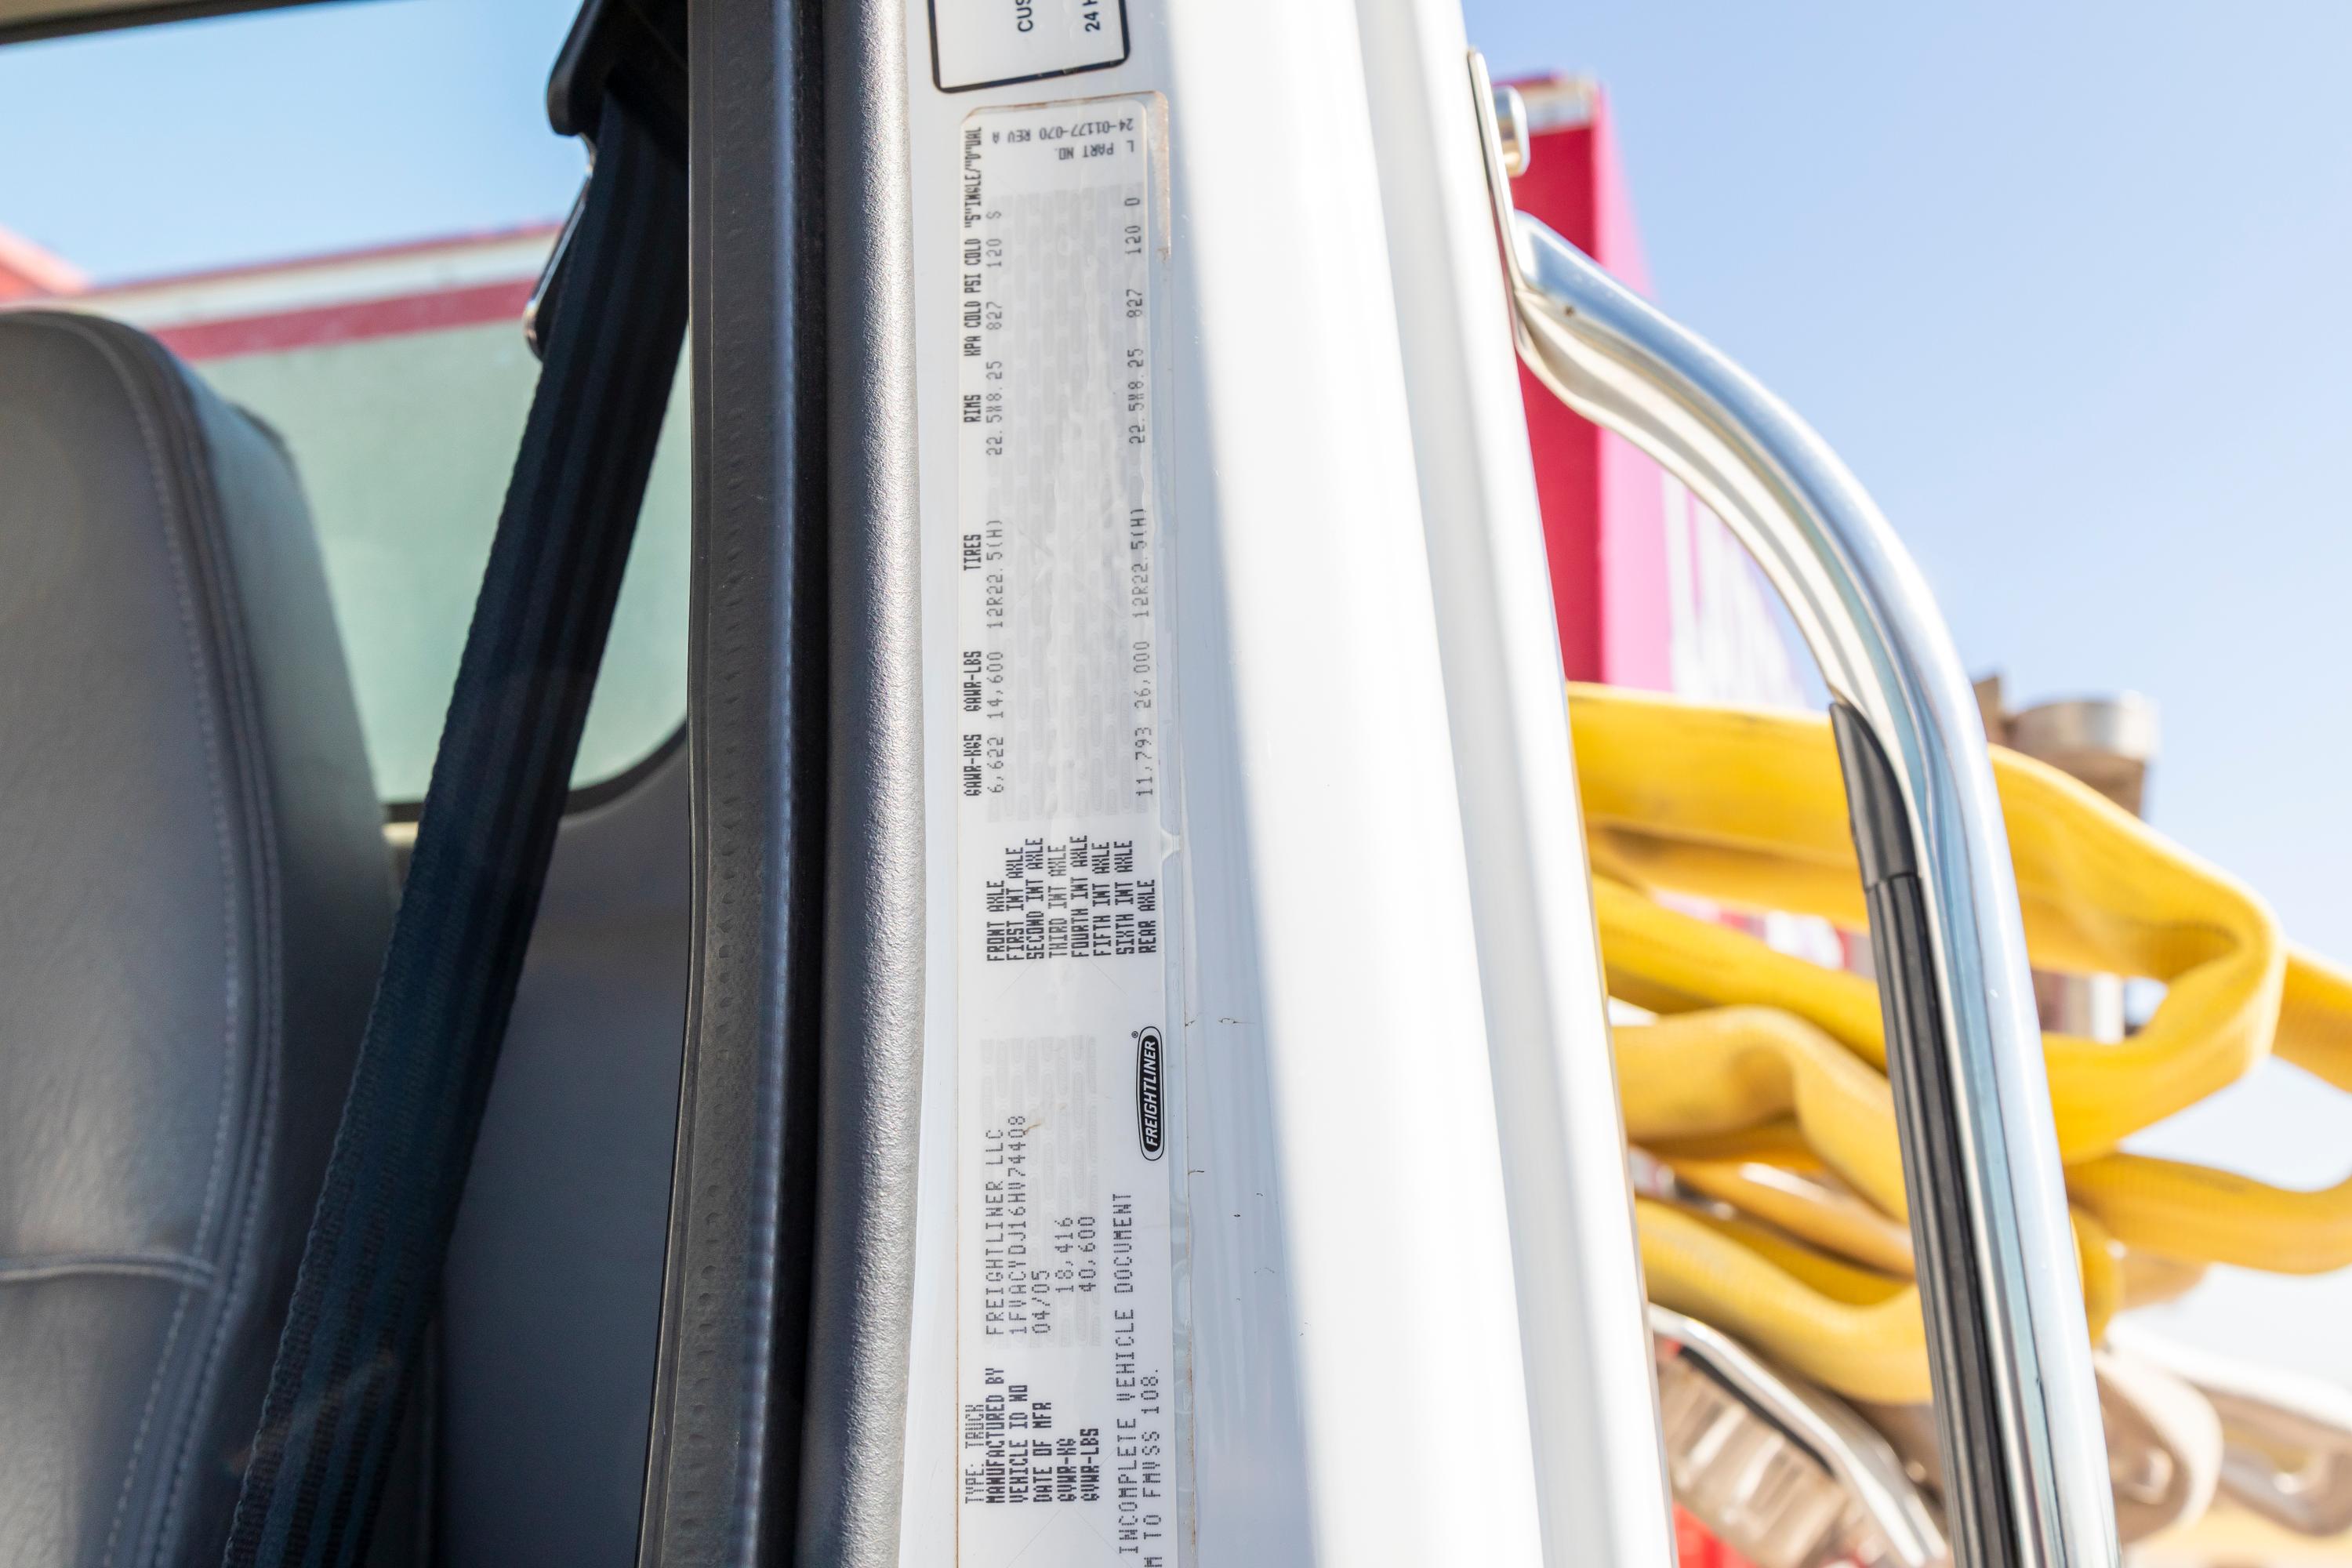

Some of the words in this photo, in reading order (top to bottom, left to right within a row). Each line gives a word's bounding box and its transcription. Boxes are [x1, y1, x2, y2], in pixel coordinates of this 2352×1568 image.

[1083, 11, 1100, 32] 24
[993, 132, 1000, 144] A
[1007, 129, 1031, 143] REV
[1039, 118, 1134, 141] 24-01177-070
[1083, 143, 1114, 158] PART
[985, 211, 1002, 220] S
[1124, 198, 1140, 206] D
[964, 238, 981, 266] COLD
[986, 238, 1002, 267] 120
[1125, 225, 1142, 254] 120
[964, 274, 981, 293] PSI
[964, 301, 981, 328] COLD
[986, 301, 1002, 330] 827
[1126, 289, 1142, 318] 827
[964, 336, 981, 356] KPA
[964, 395, 981, 423] RIMS
[964, 535, 981, 571] TIRES
[964, 651, 982, 711] GAWR-LBS
[986, 652, 1004, 718] 14,600
[1133, 641, 1151, 709] 26,000
[964, 735, 982, 796] GAWR-KGS
[987, 737, 1004, 793] 6,622
[1134, 728, 1152, 796] 11,793
[1005, 848, 1023, 878] AXLE
[1025, 838, 1043, 869] AXLE
[1047, 845, 1066, 877] AXLE
[1070, 835, 1087, 867] AXLE
[1091, 842, 1109, 874] AXLE
[1114, 840, 1133, 873] AXLE
[986, 880, 1004, 912] AXLE
[1006, 888, 1024, 911] INT
[1025, 880, 1044, 902] INT
[1047, 886, 1067, 909] INT
[1071, 877, 1088, 900] INT
[1092, 884, 1110, 907] INT
[1115, 882, 1134, 906] INT
[1137, 880, 1155, 911] AXLE
[987, 922, 1005, 961] FRONT
[1007, 921, 1024, 960] FIRST
[1026, 911, 1044, 960] SECOND
[1048, 918, 1068, 958] THIRD
[1071, 909, 1089, 957] FOURTH
[1093, 915, 1111, 956] FIFTH
[1116, 914, 1134, 955] SIXTH
[1138, 920, 1156, 953] REAR
[1142, 1040, 1159, 1148] FREIGHTLINER
[985, 1130, 1004, 1165] LLC
[985, 1181, 1004, 1335] FREIGHTLINER
[1054, 1218, 1073, 1293] 18,416
[1078, 1217, 1096, 1292] 40,600
[1112, 1194, 1133, 1293] DOCUMENT
[1031, 1271, 1051, 1334] 04/05
[1115, 1309, 1135, 1401] VEHICLE
[985, 1368, 1004, 1385] BY
[1141, 1370, 1159, 1414] 108.
[1008, 1385, 1028, 1402] NO
[965, 1405, 984, 1449] TRUCK
[1009, 1413, 1028, 1429] ID
[1033, 1403, 1051, 1428] MFR
[985, 1395, 1005, 1504] MANUFACTURED
[1033, 1439, 1052, 1456] OF
[1009, 1440, 1029, 1503] VEHICLE
[1056, 1439, 1076, 1501] GVWR-KG
[1080, 1428, 1099, 1501] GVWR-LBS
[1142, 1432, 1160, 1497] FMVSS
[965, 1464, 984, 1504] TYPE:
[1033, 1467, 1052, 1502] DATE
[1117, 1418, 1138, 1554] INCOMPLETE
[1143, 1515, 1161, 1540] TO
